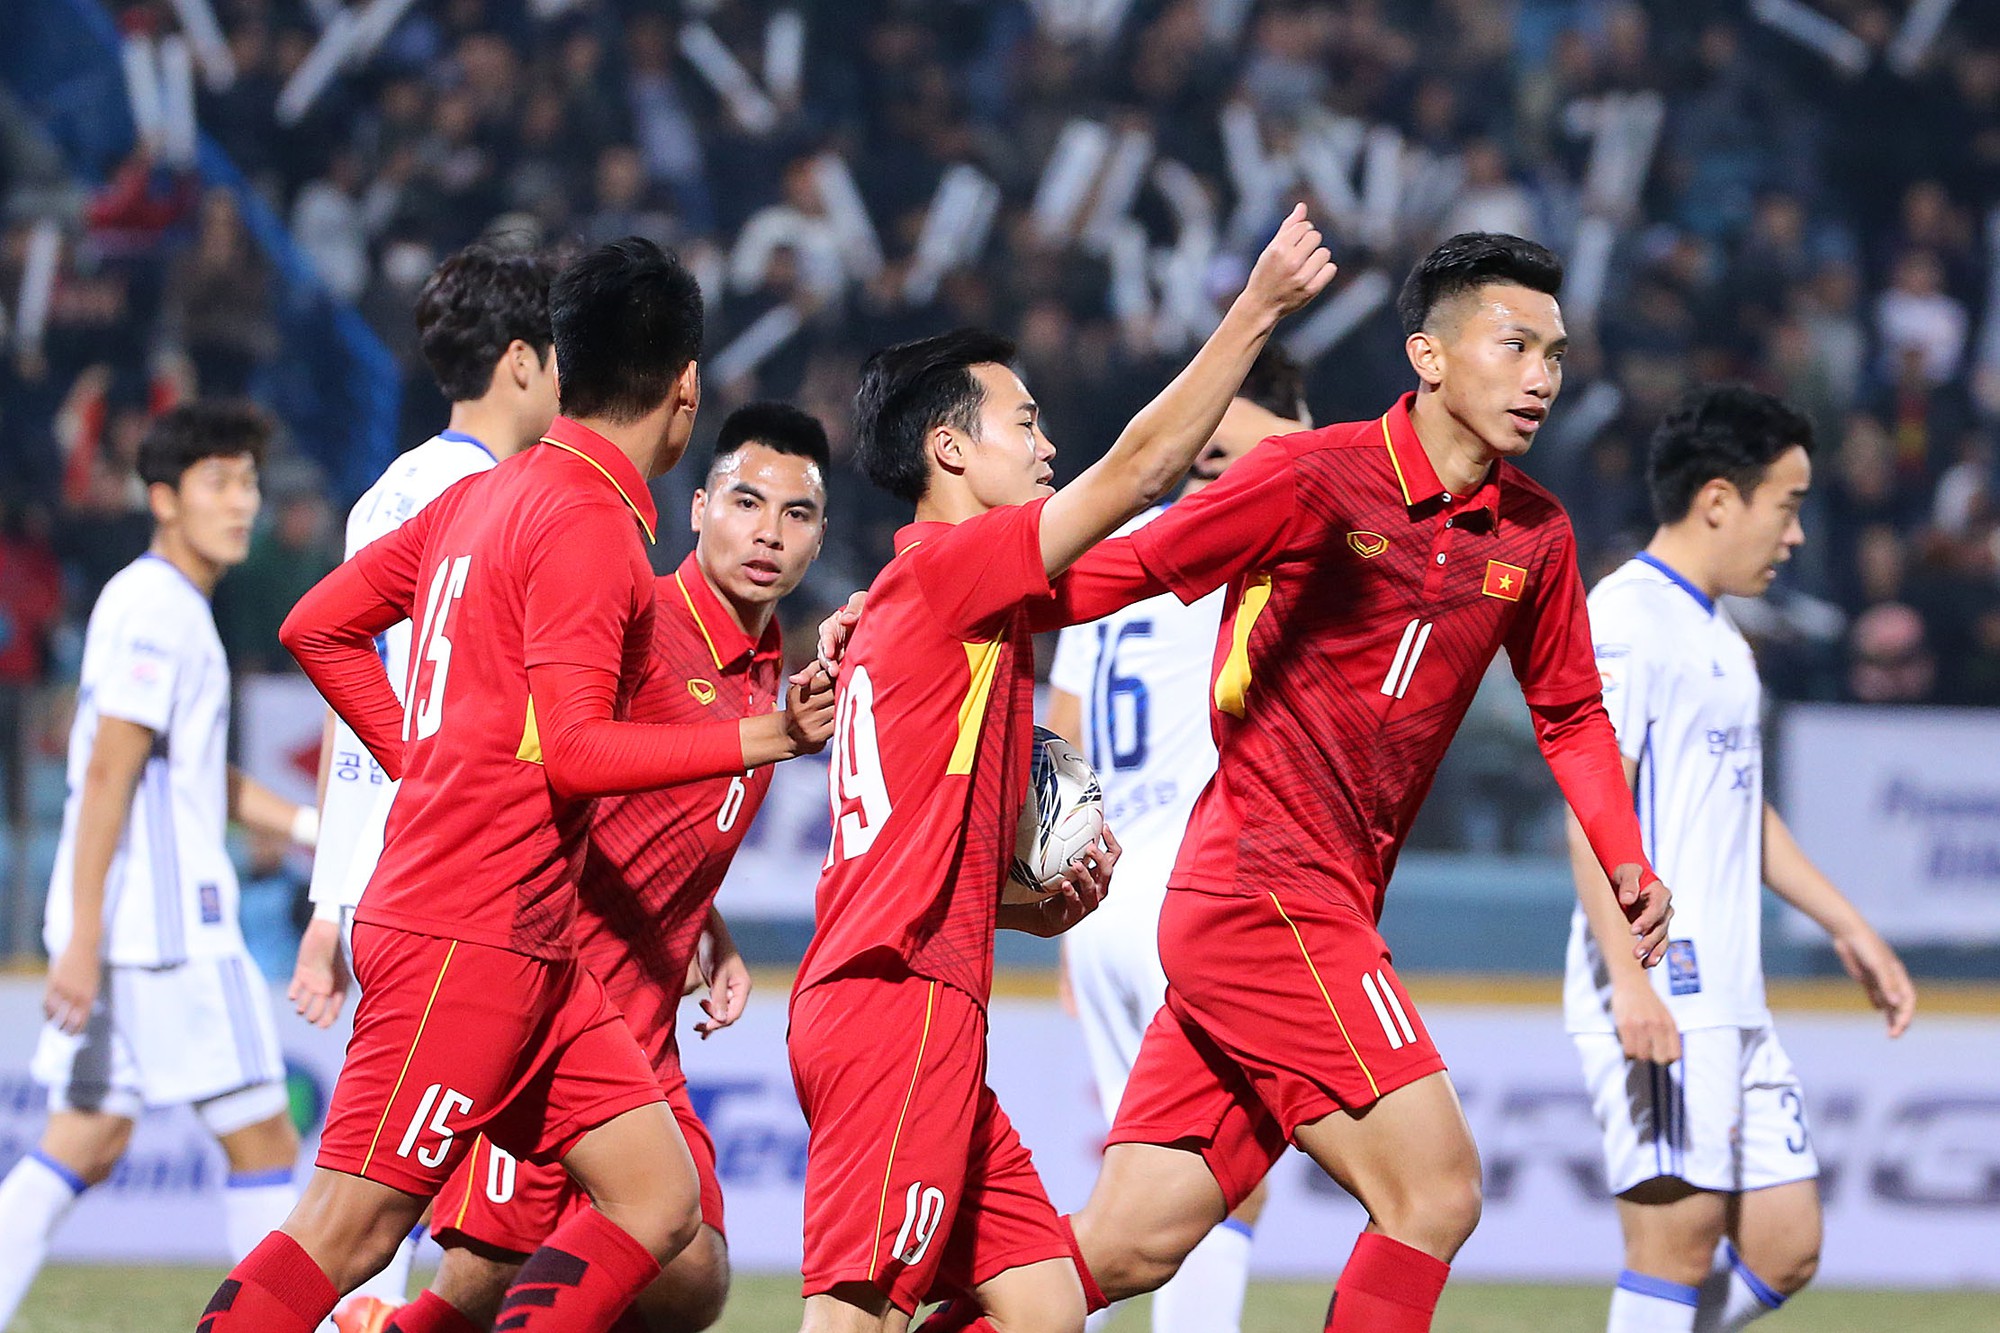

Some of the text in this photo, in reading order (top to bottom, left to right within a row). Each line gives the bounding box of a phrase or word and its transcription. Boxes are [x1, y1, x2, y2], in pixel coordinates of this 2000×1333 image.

[401, 554, 472, 742] 15
[1380, 618, 1434, 699] 11
[1091, 620, 1153, 773] 16
[716, 768, 755, 830] 6
[822, 664, 893, 870] 19
[1361, 968, 1418, 1050] 11
[396, 1083, 474, 1169] 15
[1780, 1091, 1807, 1154] 3
[891, 1181, 945, 1266] 19
